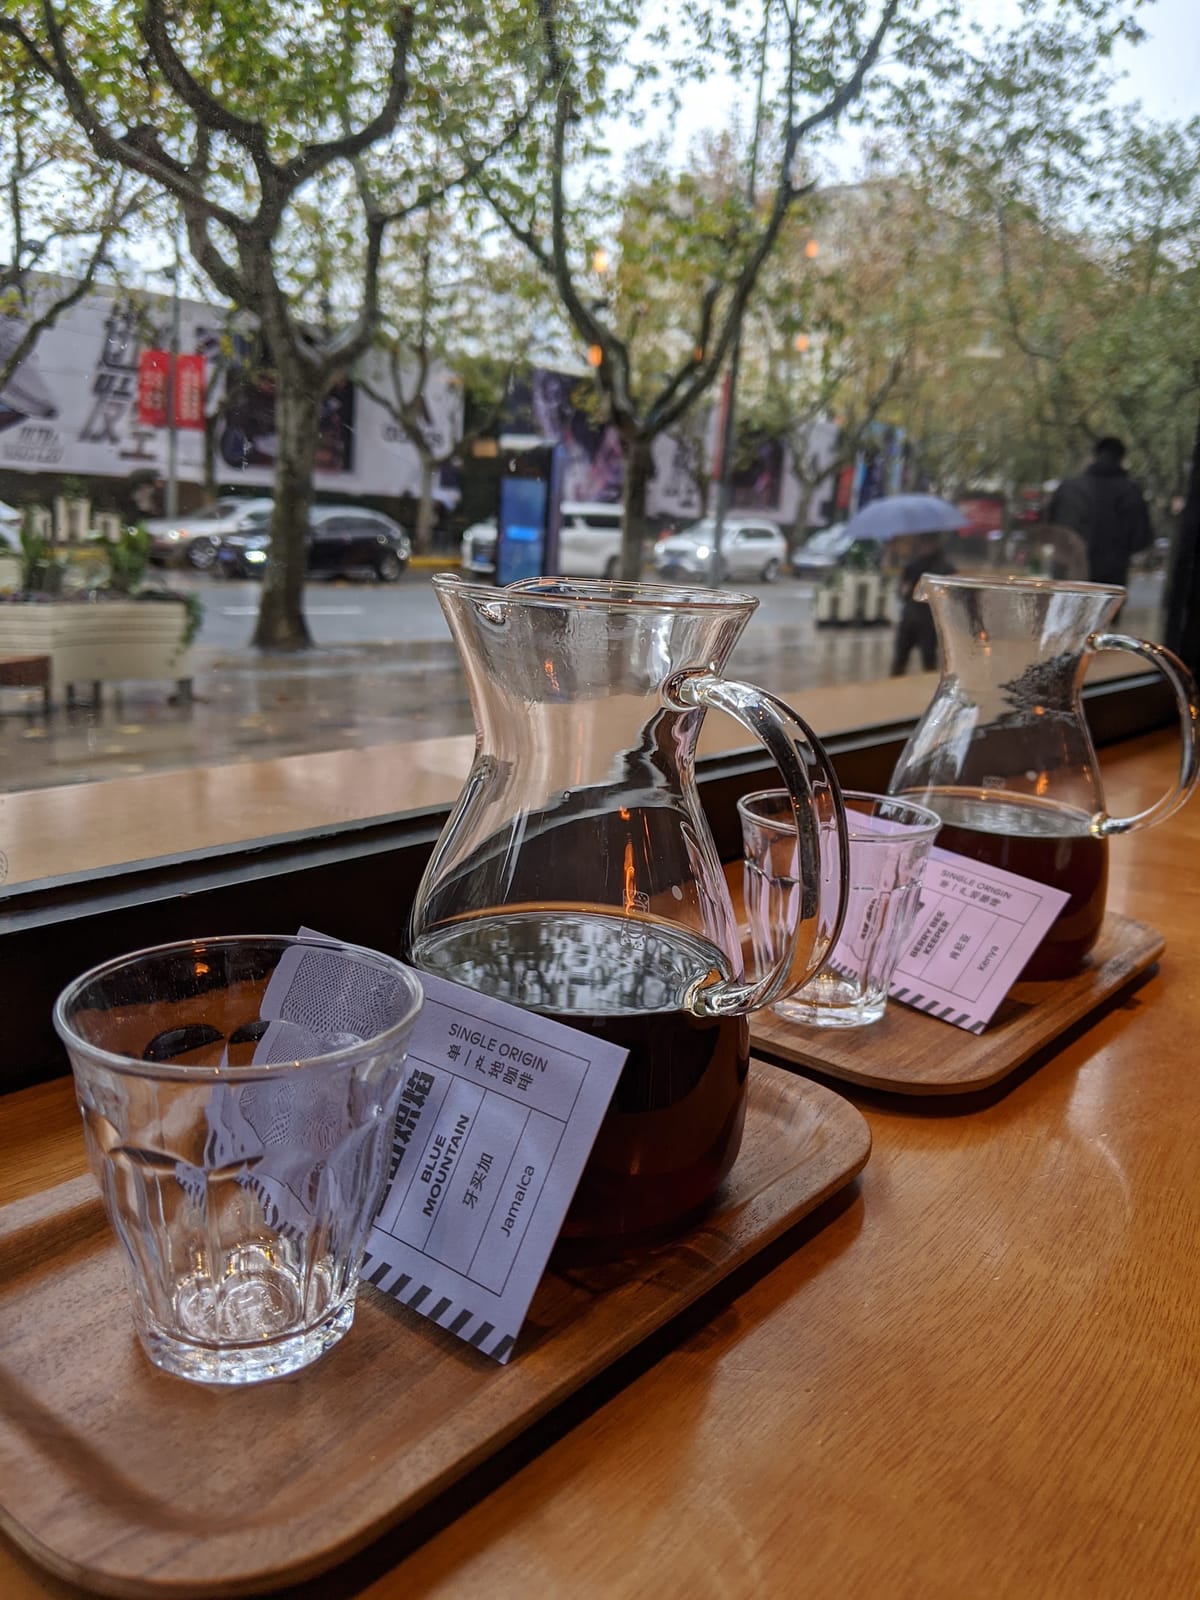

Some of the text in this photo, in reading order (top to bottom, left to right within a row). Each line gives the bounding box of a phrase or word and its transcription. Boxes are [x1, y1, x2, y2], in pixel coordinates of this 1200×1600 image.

[941, 869, 975, 887] SINGLE
[977, 882, 1012, 899] ORIGIN
[909, 910, 945, 958] BERRY BEE
[923, 920, 950, 955] KEEPER
[977, 945, 1000, 972] Kenya
[446, 1043, 534, 1092] 单一产地咖啡
[448, 1023, 549, 1073] SINGLE ORIGIN
[420, 1134, 447, 1184] BLUE
[422, 1114, 470, 1218] MOUNTAIN
[462, 1152, 494, 1210] 牙买加
[501, 1165, 535, 1238] Jamaica
